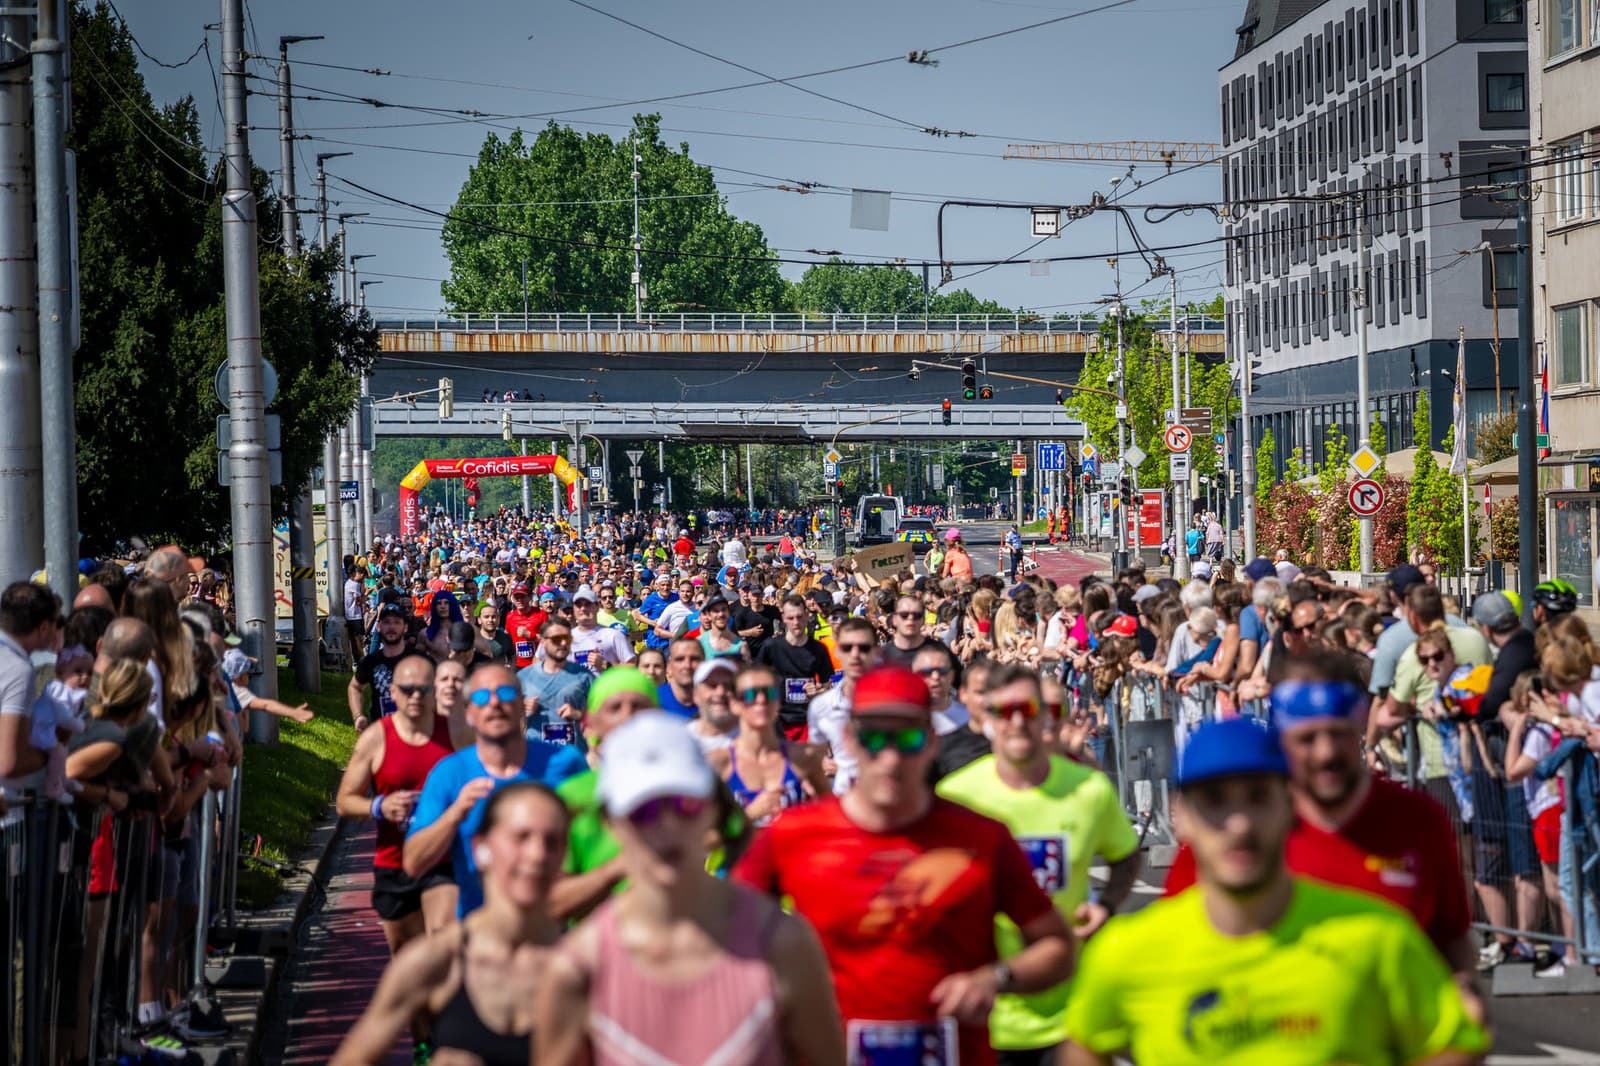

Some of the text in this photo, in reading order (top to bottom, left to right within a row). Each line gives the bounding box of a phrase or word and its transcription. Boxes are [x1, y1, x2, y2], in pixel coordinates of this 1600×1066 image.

[463, 461, 520, 474] Cofidis
[404, 498, 416, 536] ofidis
[871, 554, 905, 568] FOREST
